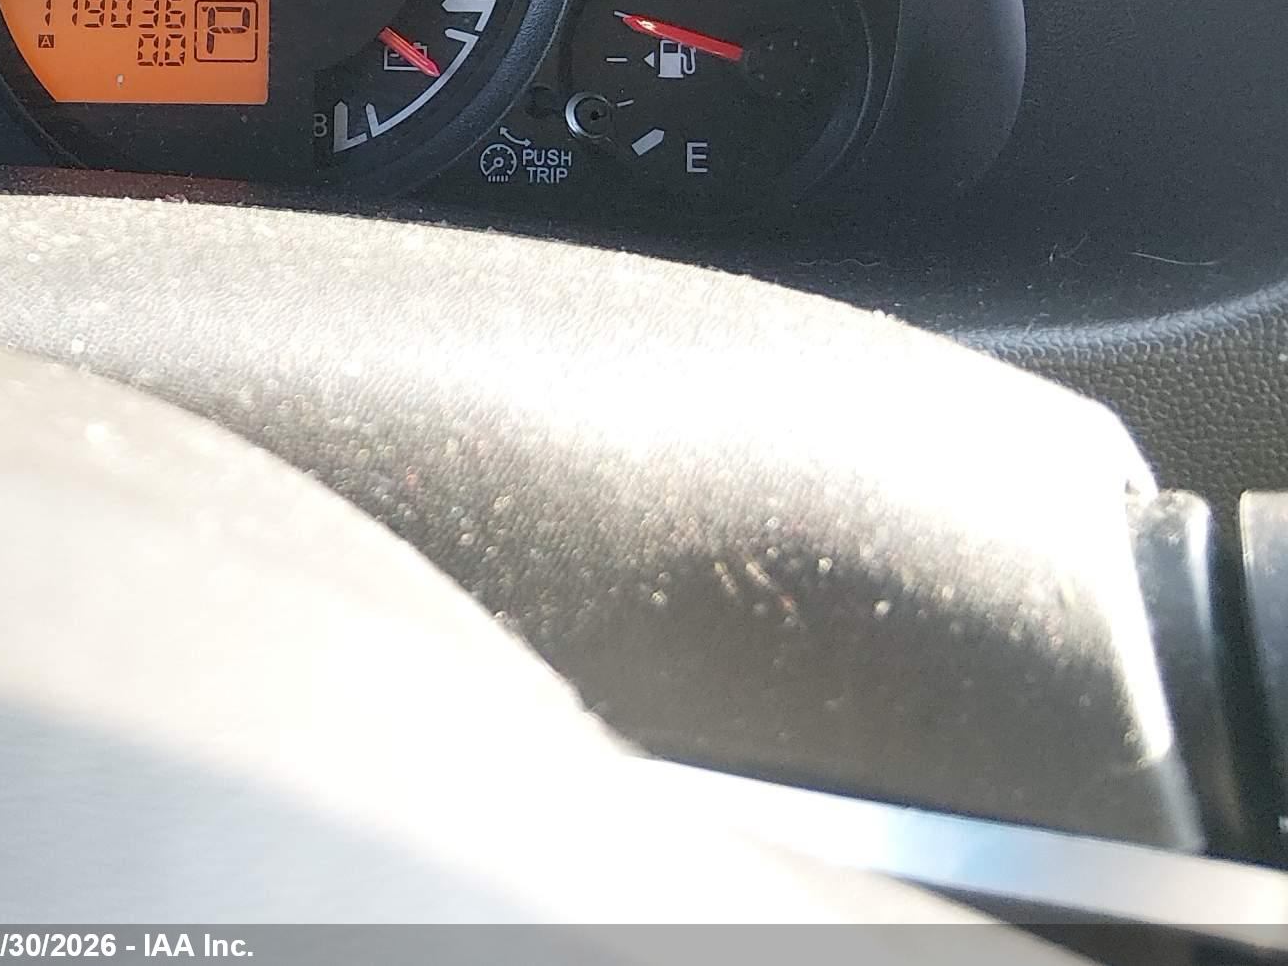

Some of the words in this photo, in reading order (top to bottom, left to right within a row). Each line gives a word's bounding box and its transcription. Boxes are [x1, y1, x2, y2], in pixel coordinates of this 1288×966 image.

[201, 6, 251, 55] P
[137, 34, 186, 66] 0.0
[522, 149, 572, 166] PUSH
[686, 142, 708, 173] E
[526, 167, 568, 183] TRIP
